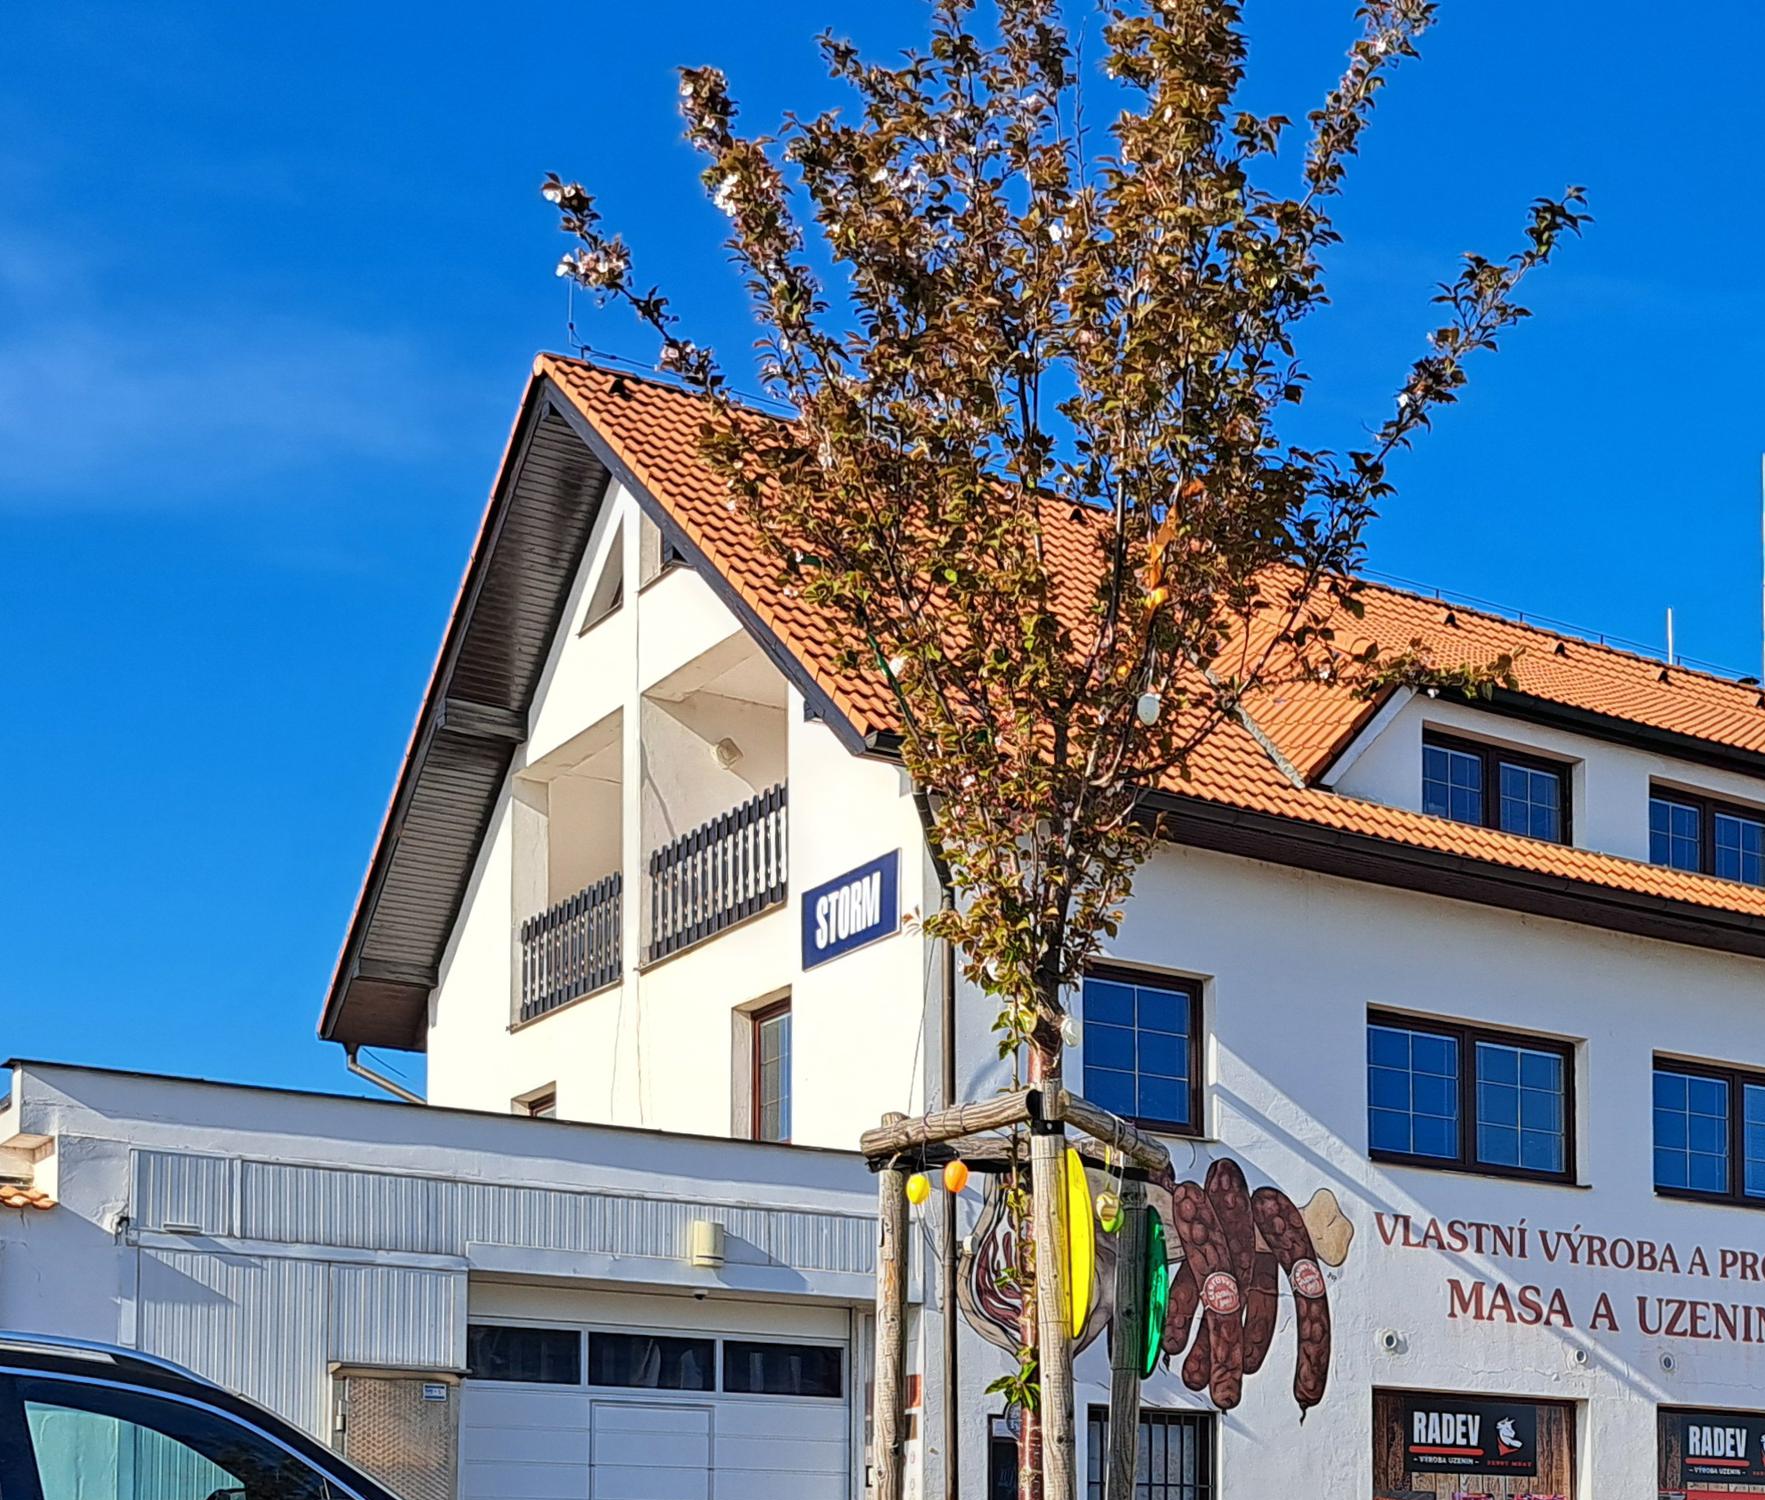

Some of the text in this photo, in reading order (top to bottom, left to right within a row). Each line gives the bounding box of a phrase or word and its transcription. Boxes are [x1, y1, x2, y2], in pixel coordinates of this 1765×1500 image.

[816, 871, 881, 950] STORM
[1374, 1212, 1528, 1258] VLASTNÍ
[1538, 1224, 1680, 1274] VÝROBA
[1687, 1246, 1710, 1276] A
[1447, 1278, 1574, 1328] MASA
[1589, 1292, 1619, 1331] A
[1413, 1411, 1480, 1446] RADEV
[1688, 1425, 1747, 1458] RADEV
